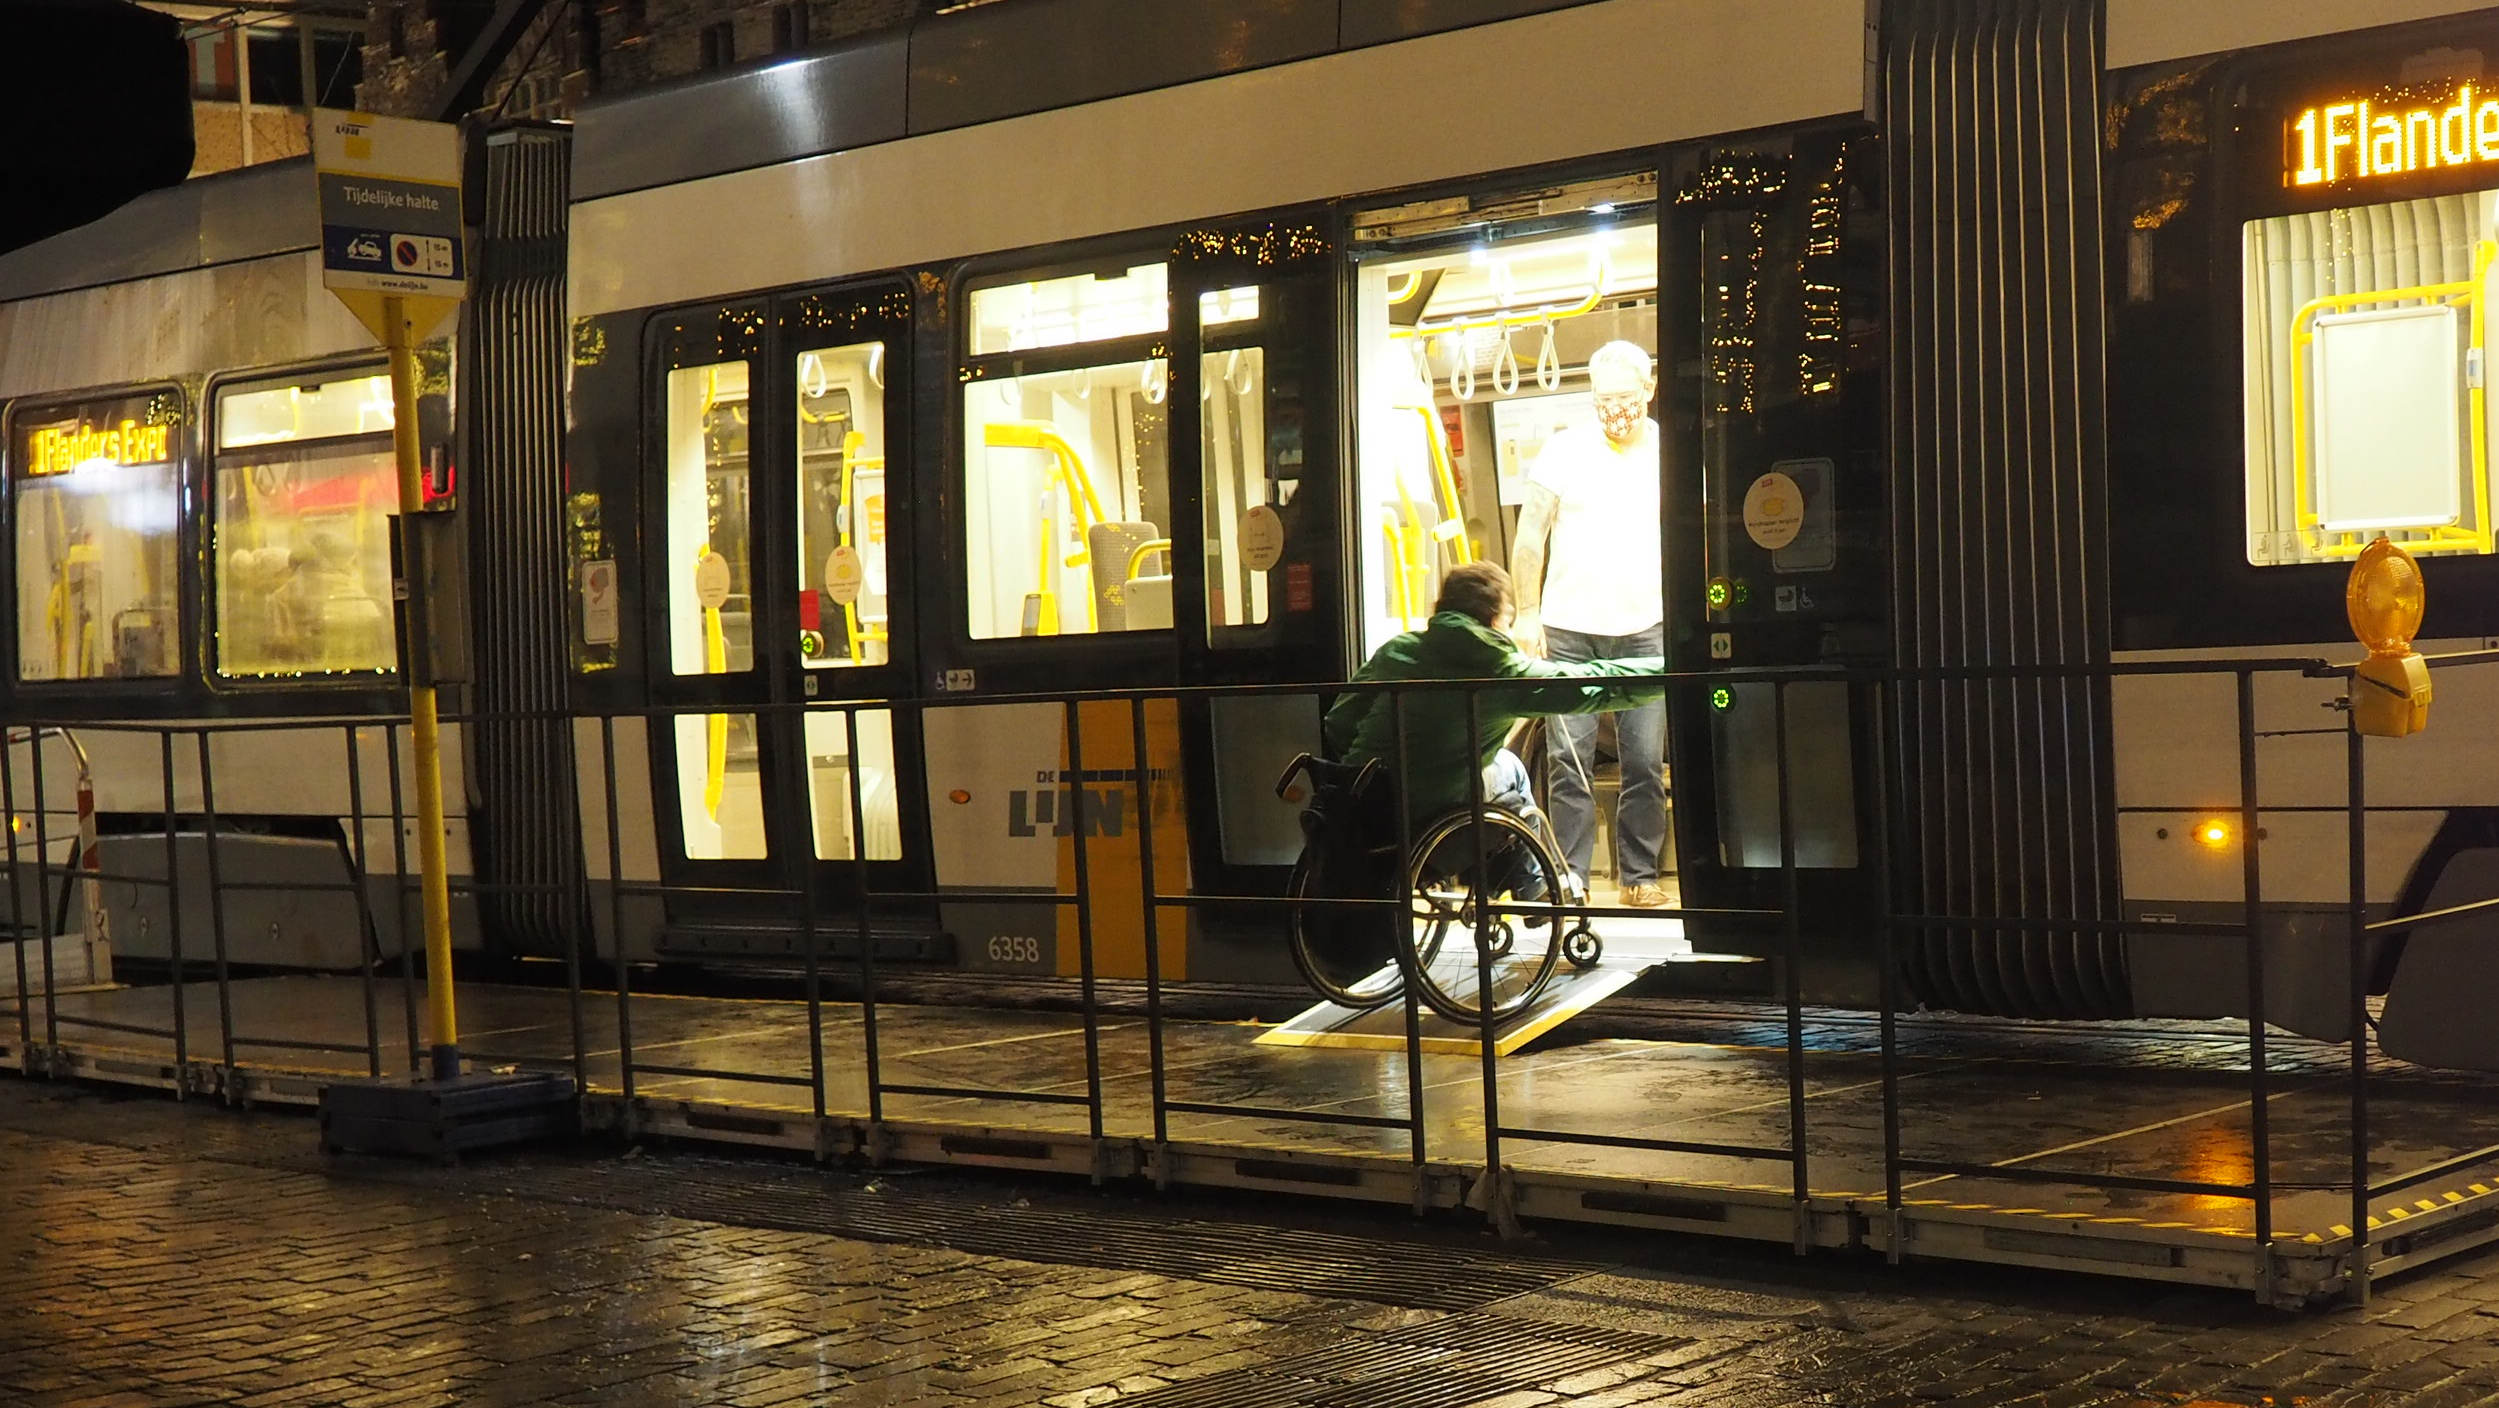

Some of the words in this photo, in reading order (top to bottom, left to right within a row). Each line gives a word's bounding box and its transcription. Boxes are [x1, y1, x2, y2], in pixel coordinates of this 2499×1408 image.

[343, 186, 404, 208] Tijdelijke
[406, 192, 439, 211] halte
[1036, 770, 1055, 783] DE
[1009, 790, 1123, 838] LIJN
[988, 936, 1039, 963] 6358
